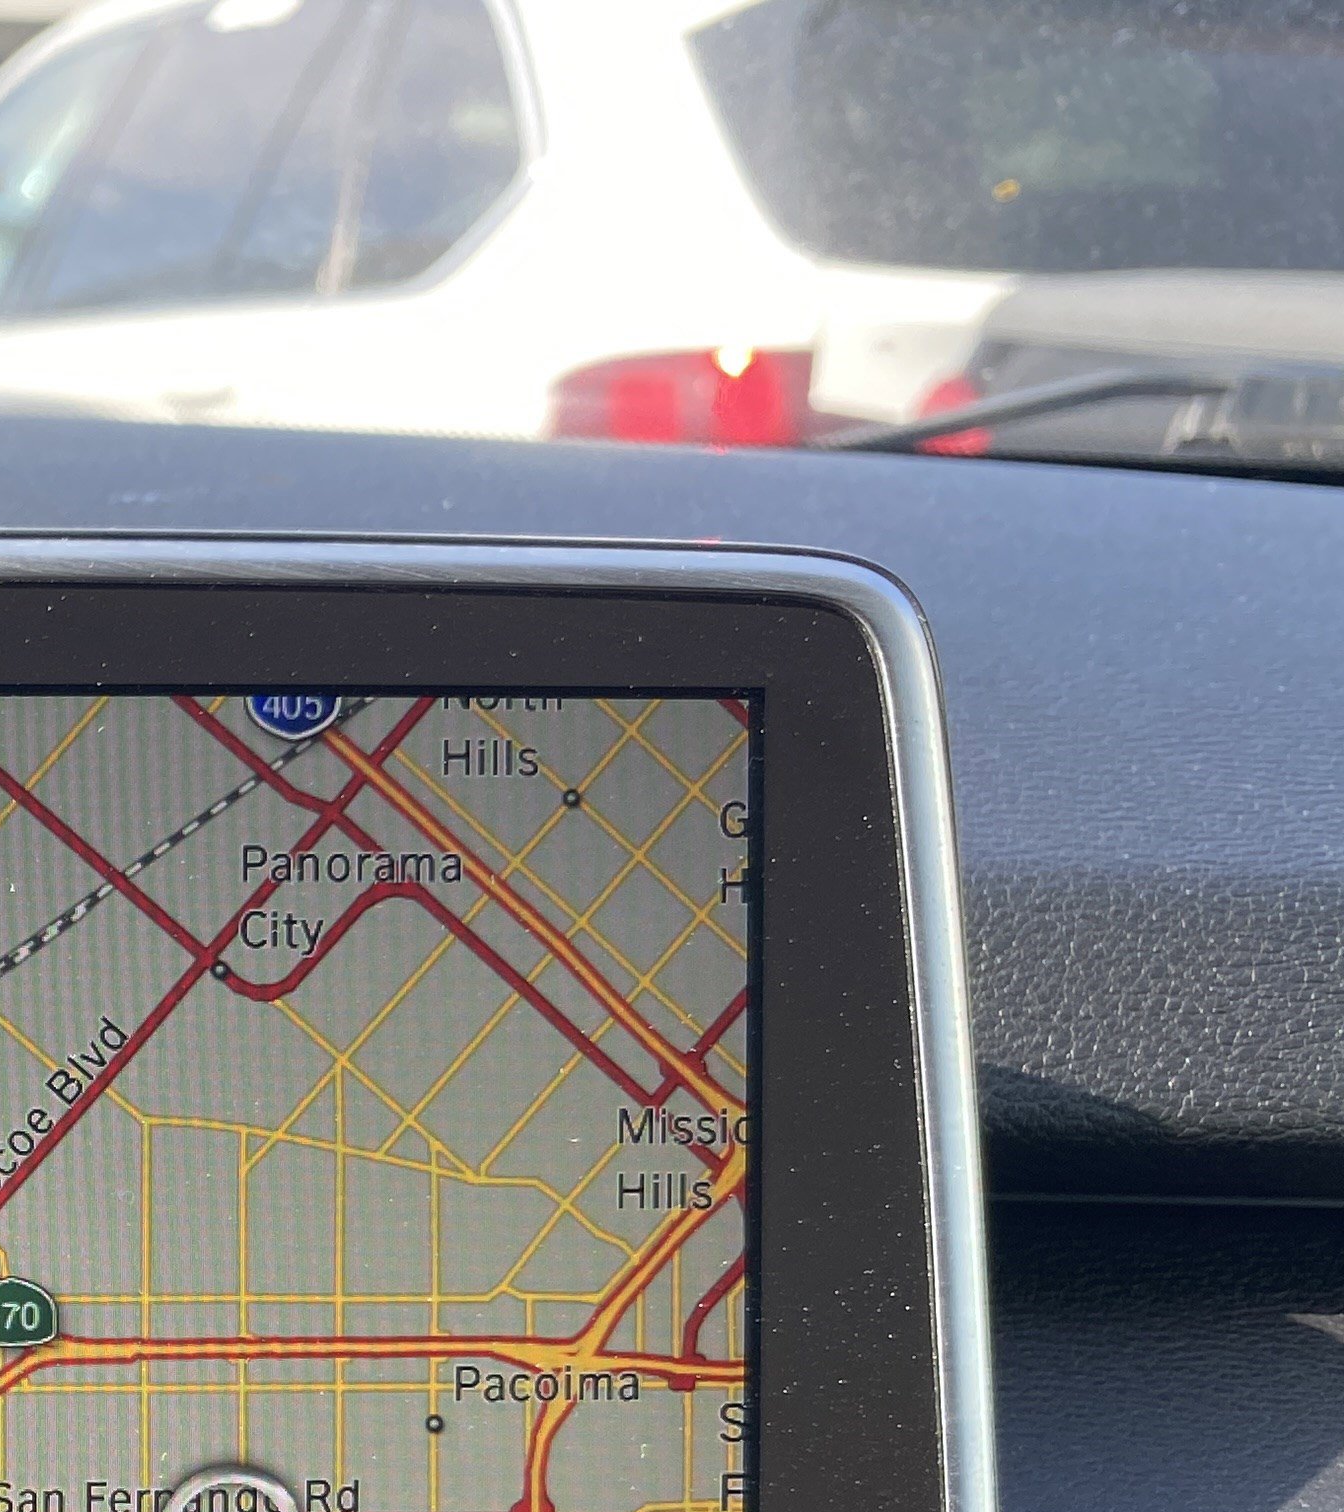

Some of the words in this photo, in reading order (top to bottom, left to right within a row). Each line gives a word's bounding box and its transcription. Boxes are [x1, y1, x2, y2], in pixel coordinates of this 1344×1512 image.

[442, 738, 539, 776] Hills
[241, 845, 463, 883] Panorama
[239, 910, 325, 956] City
[44, 1015, 129, 1106] Blvd
[617, 1173, 713, 1210] Hills
[454, 1366, 640, 1402] Pacoima
